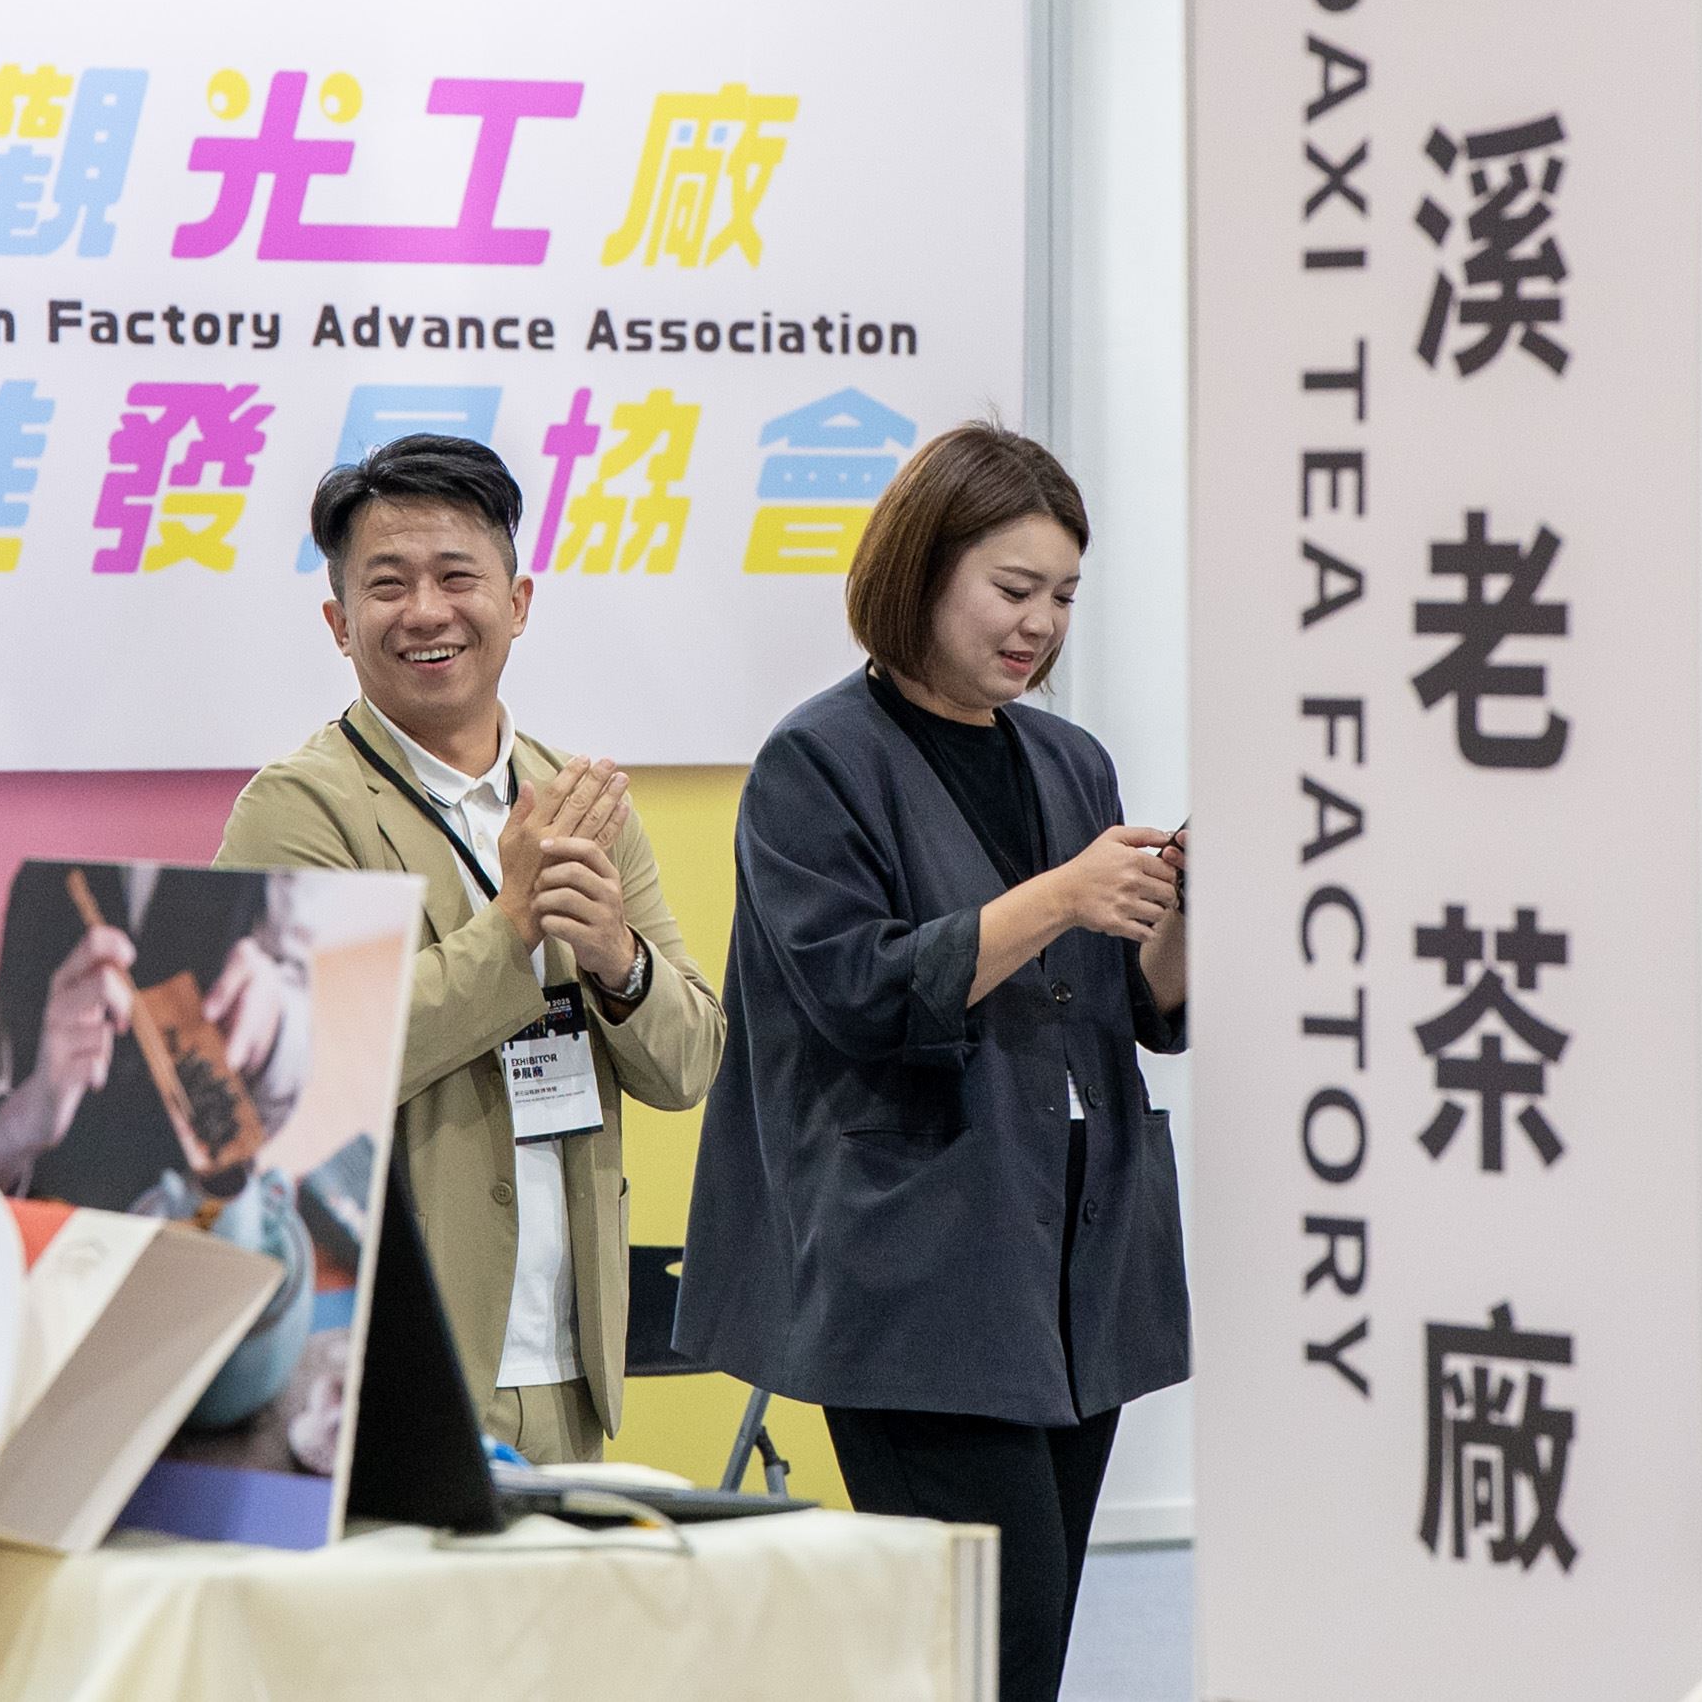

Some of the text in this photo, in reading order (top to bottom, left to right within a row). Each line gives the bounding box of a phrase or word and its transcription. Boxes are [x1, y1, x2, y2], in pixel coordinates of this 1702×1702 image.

[47, 299, 282, 351] Factory
[311, 303, 556, 352] Advance
[586, 308, 919, 356] Association
[1299, 337, 1368, 631] TEA
[510, 1053, 559, 1067] EXHIBITOR
[1298, 695, 1372, 1400] FACTORY
